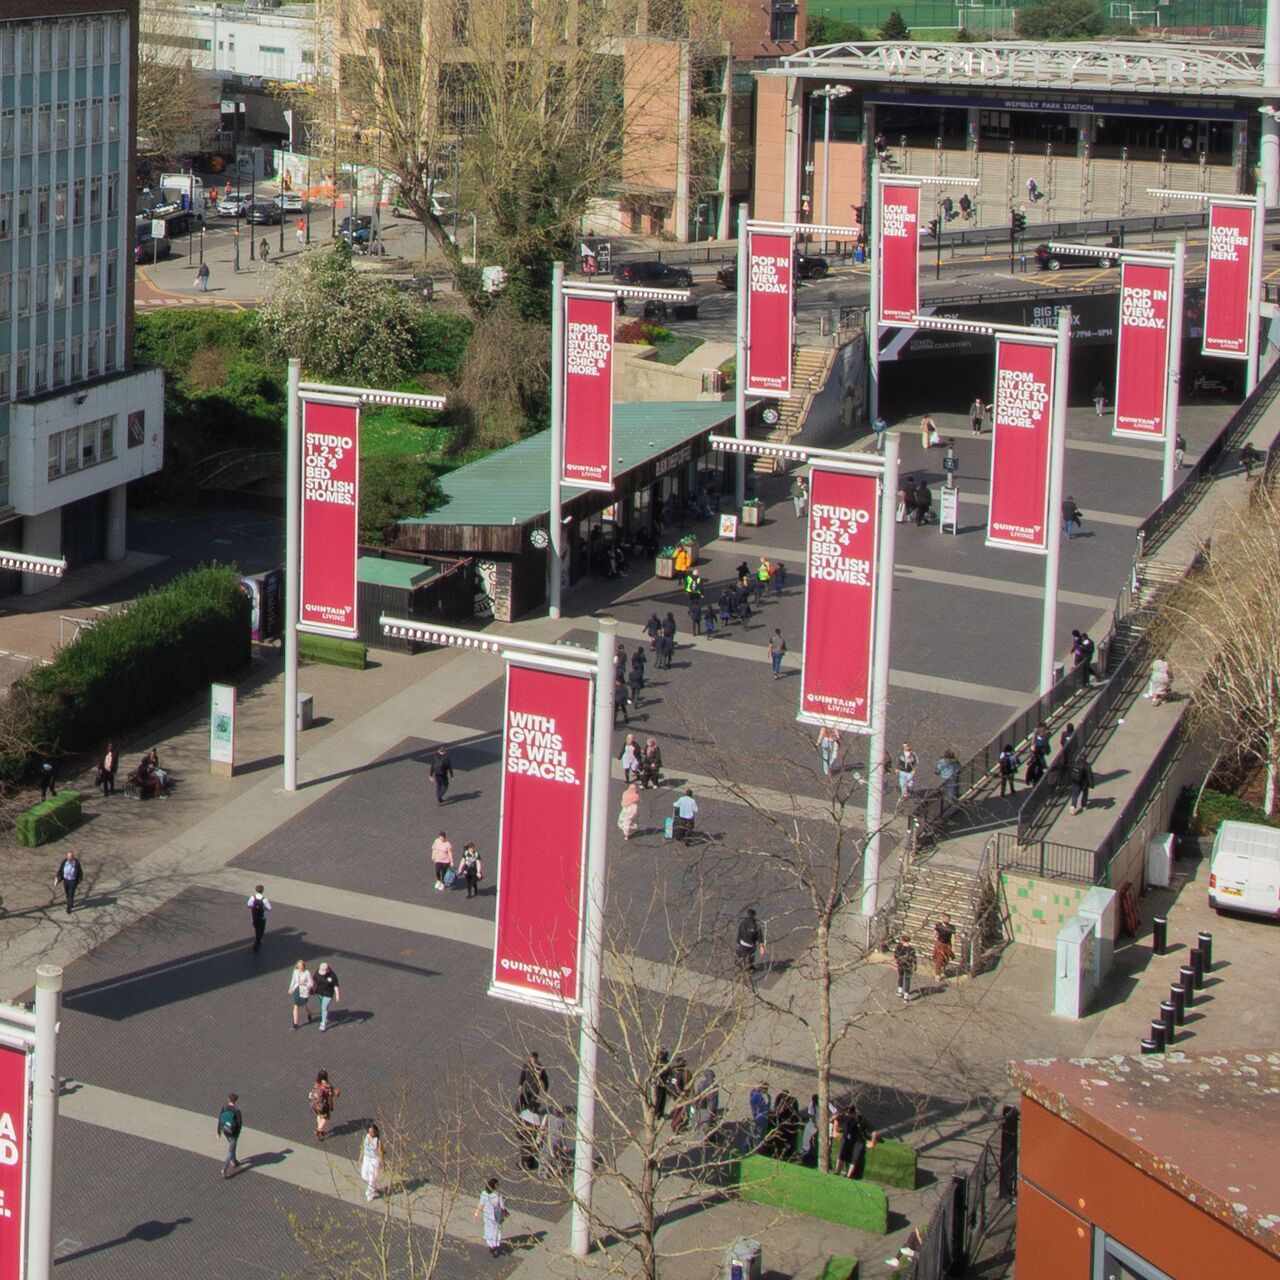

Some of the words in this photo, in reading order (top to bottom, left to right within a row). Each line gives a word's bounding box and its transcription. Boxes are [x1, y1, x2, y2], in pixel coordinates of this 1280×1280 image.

[884, 204, 908, 214] LOVE
[884, 213, 916, 222] WHERE
[884, 220, 904, 229] YOU
[884, 228, 908, 237] RENT.
[1212, 226, 1239, 236] LOVE
[1212, 235, 1248, 246] WHERE
[1211, 243, 1234, 252] YOU
[752, 256, 775, 265] POP
[777, 257, 788, 267] IN
[1211, 251, 1239, 261] RENT.
[752, 264, 775, 274] AND
[752, 274, 778, 283] VIEW
[752, 282, 788, 293] TODAY.
[1124, 287, 1151, 298] POP
[1153, 288, 1167, 301] IN
[1123, 297, 1151, 308] AND
[1034, 307, 1050, 317] BIG
[1123, 307, 1155, 318] VIEW
[569, 323, 597, 333] FROM
[1123, 315, 1165, 329] TODAY.
[569, 332, 583, 341] NY
[584, 333, 608, 343] LOFT
[568, 341, 595, 350] STYLE
[596, 342, 610, 351] TO
[568, 348, 607, 360] SCANDI
[568, 357, 595, 367] CHIC
[597, 359, 605, 368] &
[568, 365, 600, 376] MORE.
[999, 369, 1033, 382] FROM
[999, 379, 1016, 389] NY
[1018, 381, 1046, 392] LOFT
[998, 389, 1030, 400] STYLE
[1032, 392, 1048, 402] TO
[998, 398, 1044, 411] SCANDI
[998, 407, 1029, 418] CHIC
[1032, 409, 1042, 420] &
[998, 416, 1035, 428] MORE.
[306, 433, 352, 449] STUDIO
[308, 444, 318, 457] 1,
[321, 446, 332, 459] 2,
[335, 448, 343, 459] 3
[306, 456, 325, 468] OR
[328, 458, 337, 469] 4
[567, 464, 601, 472] QUINTAIN
[307, 467, 330, 479] BED
[306, 478, 354, 494] STYLISH
[306, 489, 354, 506] HOMES.
[813, 504, 869, 523] STUDIO
[814, 517, 826, 532] 1,
[830, 519, 844, 535] 2,
[847, 521, 858, 534] 3
[993, 523, 1034, 534] QUINTAIN
[812, 530, 836, 543] OR
[839, 533, 849, 546] 4
[1010, 532, 1034, 540] LIVING
[812, 542, 841, 556] BED
[811, 554, 870, 574] STYLISH
[811, 566, 870, 587] HOMES.
[305, 604, 345, 616] QUINTAIN
[322, 613, 345, 622] LIVING
[807, 694, 856, 708] QUINTAIN
[828, 704, 855, 715] LIVING
[510, 711, 555, 733] WITH
[509, 727, 563, 750] GYMS
[509, 743, 522, 758] &
[526, 745, 567, 766] WFH
[508, 758, 580, 785] SPACES.
[501, 958, 561, 979] QUINTAIN
[527, 973, 560, 990] LIVING
